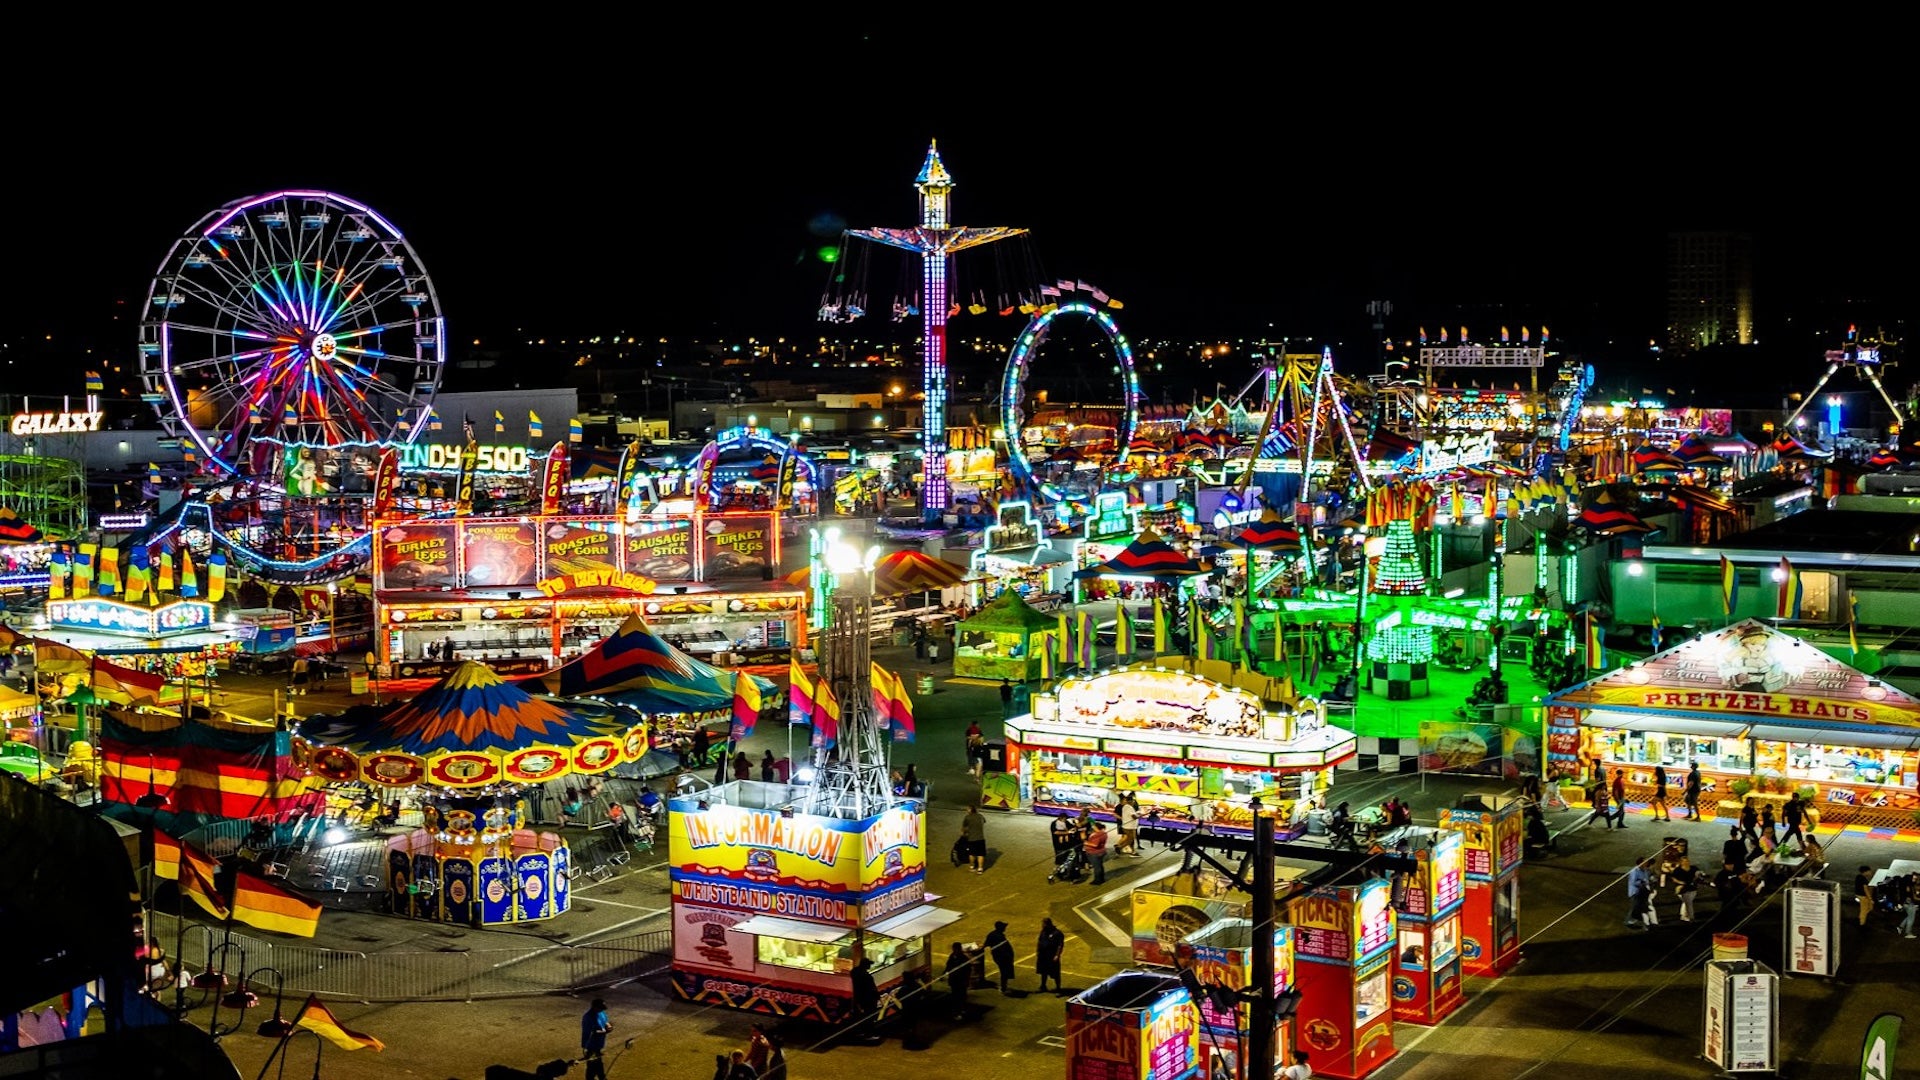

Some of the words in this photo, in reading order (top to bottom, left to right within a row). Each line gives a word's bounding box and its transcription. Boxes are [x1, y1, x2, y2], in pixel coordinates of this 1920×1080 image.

[11, 411, 104, 435] GALAXY
[399, 445, 461, 468] INDY
[477, 446, 528, 471] 500
[379, 465, 392, 501] BBQ
[460, 458, 475, 500] BBQ
[547, 461, 562, 498] BBQ
[621, 457, 637, 499] BBQ
[699, 459, 713, 496] BBQ
[782, 455, 796, 496] BBQ
[385, 538, 448, 554] TURKEY
[548, 533, 609, 556] ROASTED
[574, 547, 609, 555] CORN
[628, 532, 689, 552] SAUSAGE
[652, 547, 688, 557] STICK
[706, 530, 764, 547] TURKEY
[732, 542, 764, 556] LEGS
[414, 550, 447, 564] LEGS
[536, 570, 612, 597] TUKEY
[1645, 692, 1780, 711] PRETZEL
[1789, 698, 1869, 721] HAUS
[684, 811, 843, 867] INFORMATION
[863, 811, 921, 868] INFORMATION
[680, 879, 772, 911] WRISTBAND
[776, 891, 847, 921] STATION
[1290, 896, 1350, 936] TICKETS
[703, 979, 750, 997] GUEST
[752, 987, 818, 1007] SERVICES
[1070, 1018, 1139, 1066] TICKETS
